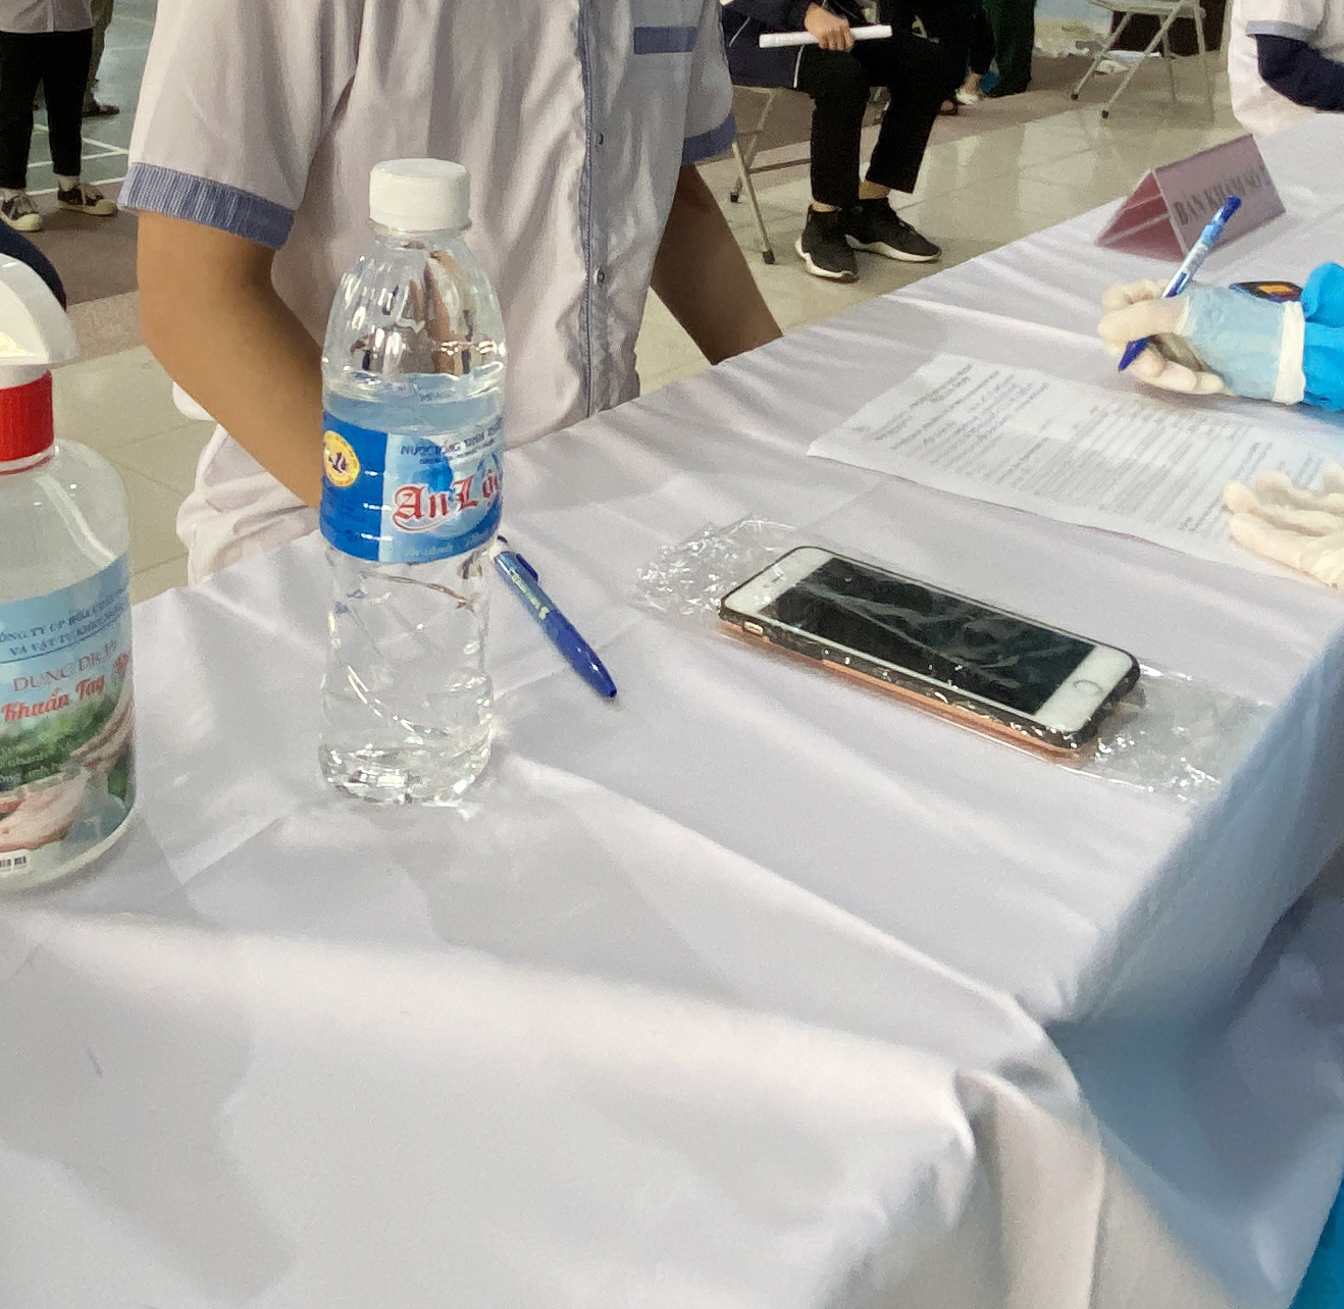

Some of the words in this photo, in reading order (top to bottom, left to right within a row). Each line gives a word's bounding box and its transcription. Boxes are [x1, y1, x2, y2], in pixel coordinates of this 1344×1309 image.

[392, 485, 450, 531] An
[29, 626, 47, 637] TY
[0, 687, 71, 723] Khuẩn
[75, 674, 106, 701] Tay
